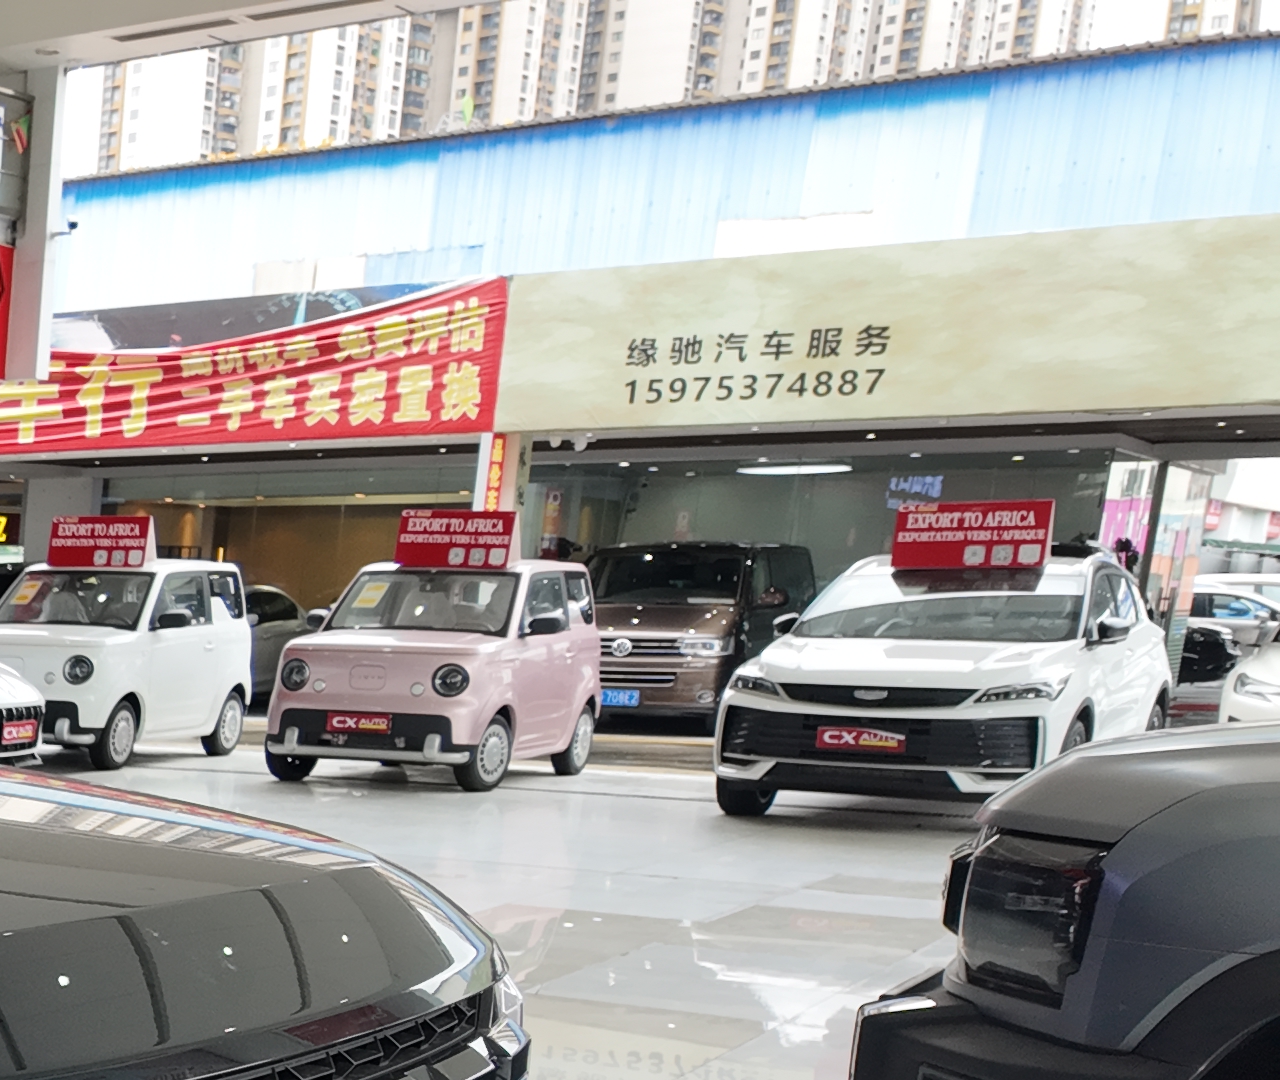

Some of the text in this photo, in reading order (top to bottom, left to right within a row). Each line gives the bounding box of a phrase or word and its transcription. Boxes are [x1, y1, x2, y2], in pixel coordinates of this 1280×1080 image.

[334, 296, 489, 362] 免费评估
[626, 323, 892, 370] 缘驰汽车服务
[623, 368, 886, 406] 15975374887
[177, 361, 481, 432] 二手车买卖置换
[407, 518, 504, 533] EXPORT TO AFRICA
[906, 510, 1036, 529] EXPORT TO AFRICA
[58, 523, 140, 536] EXPORT TO AFRICA
[897, 531, 966, 542] EXPORTATION
[966, 530, 992, 541] VERS
[332, 716, 388, 728] CX AUTO
[823, 730, 898, 744] CX AUTO
